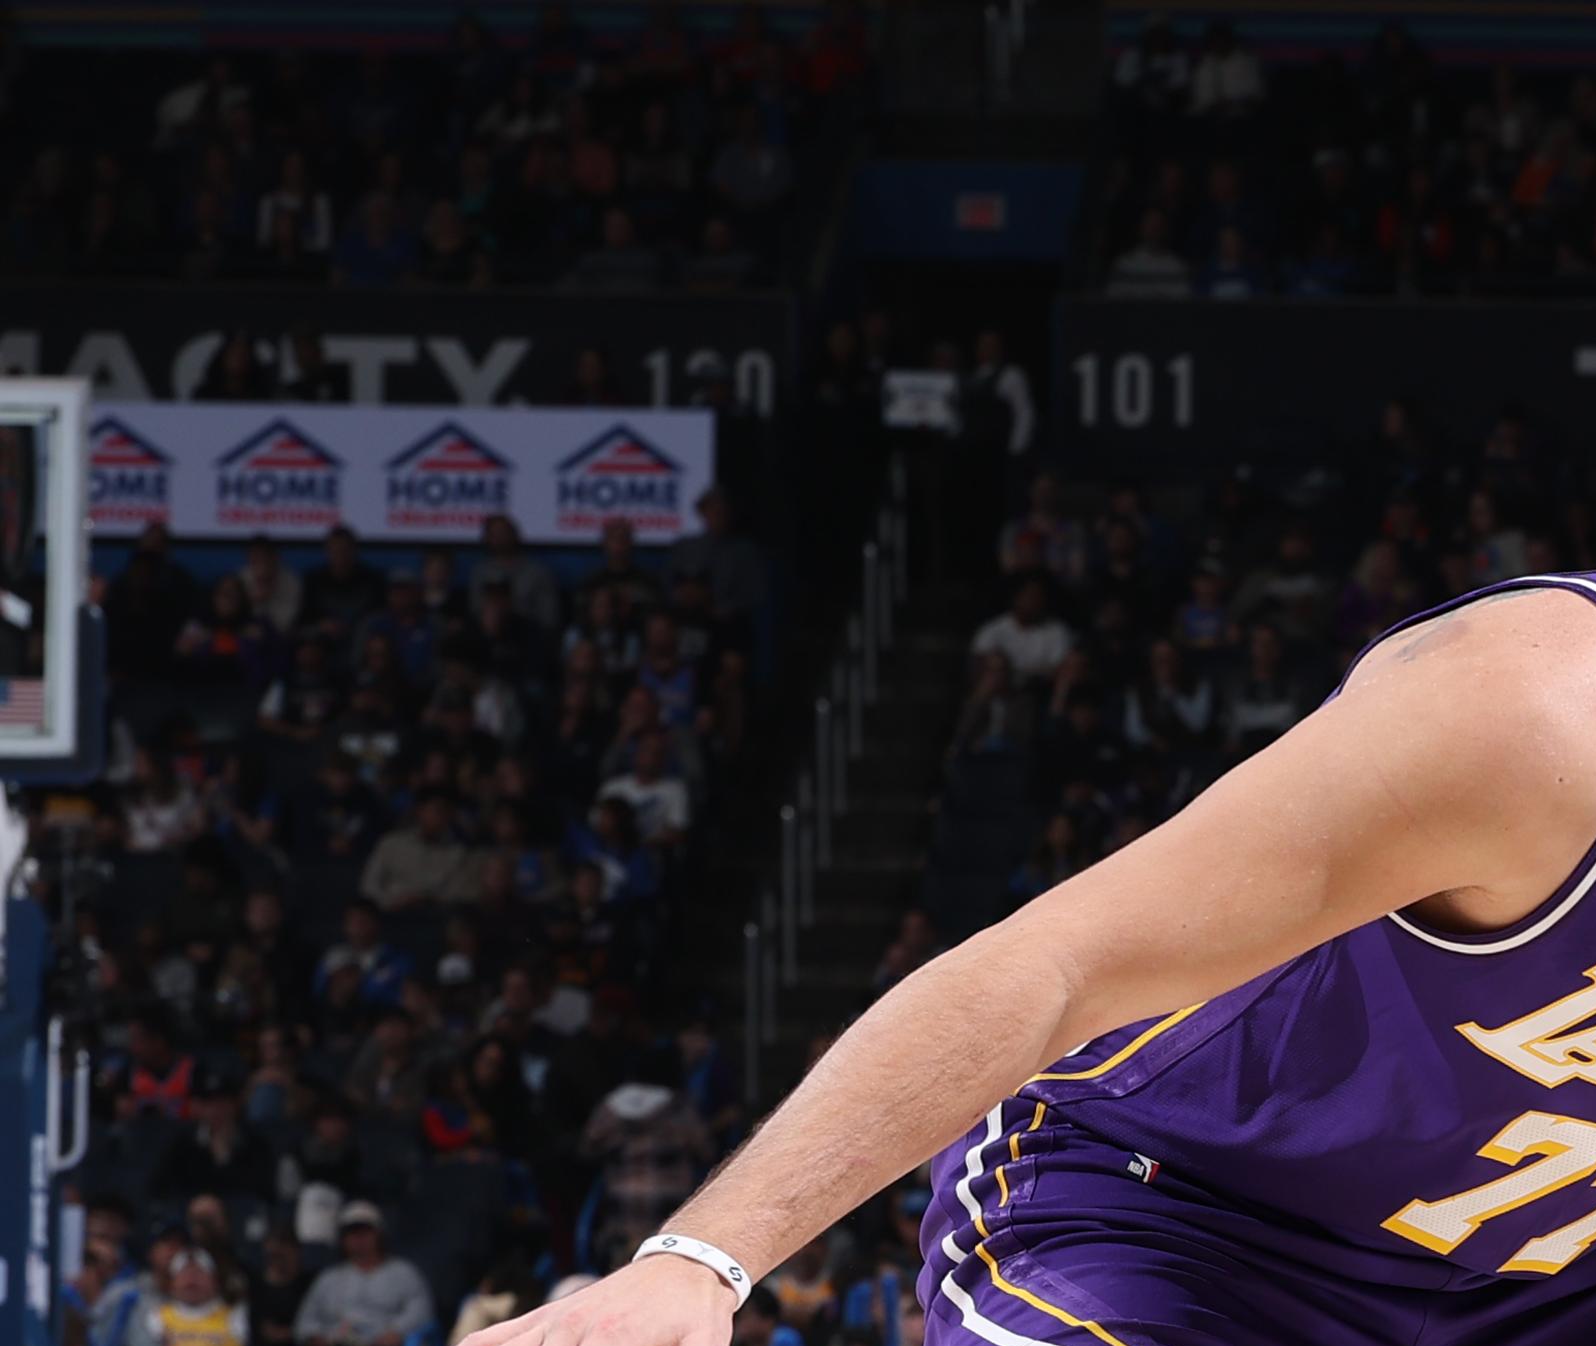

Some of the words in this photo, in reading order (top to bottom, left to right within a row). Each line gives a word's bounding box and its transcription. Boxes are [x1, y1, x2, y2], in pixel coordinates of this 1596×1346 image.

[1069, 349, 1196, 429] 101
[89, 473, 169, 501] OME
[217, 474, 341, 503] HOME
[387, 477, 508, 506] HOME
[556, 480, 679, 509] HOME
